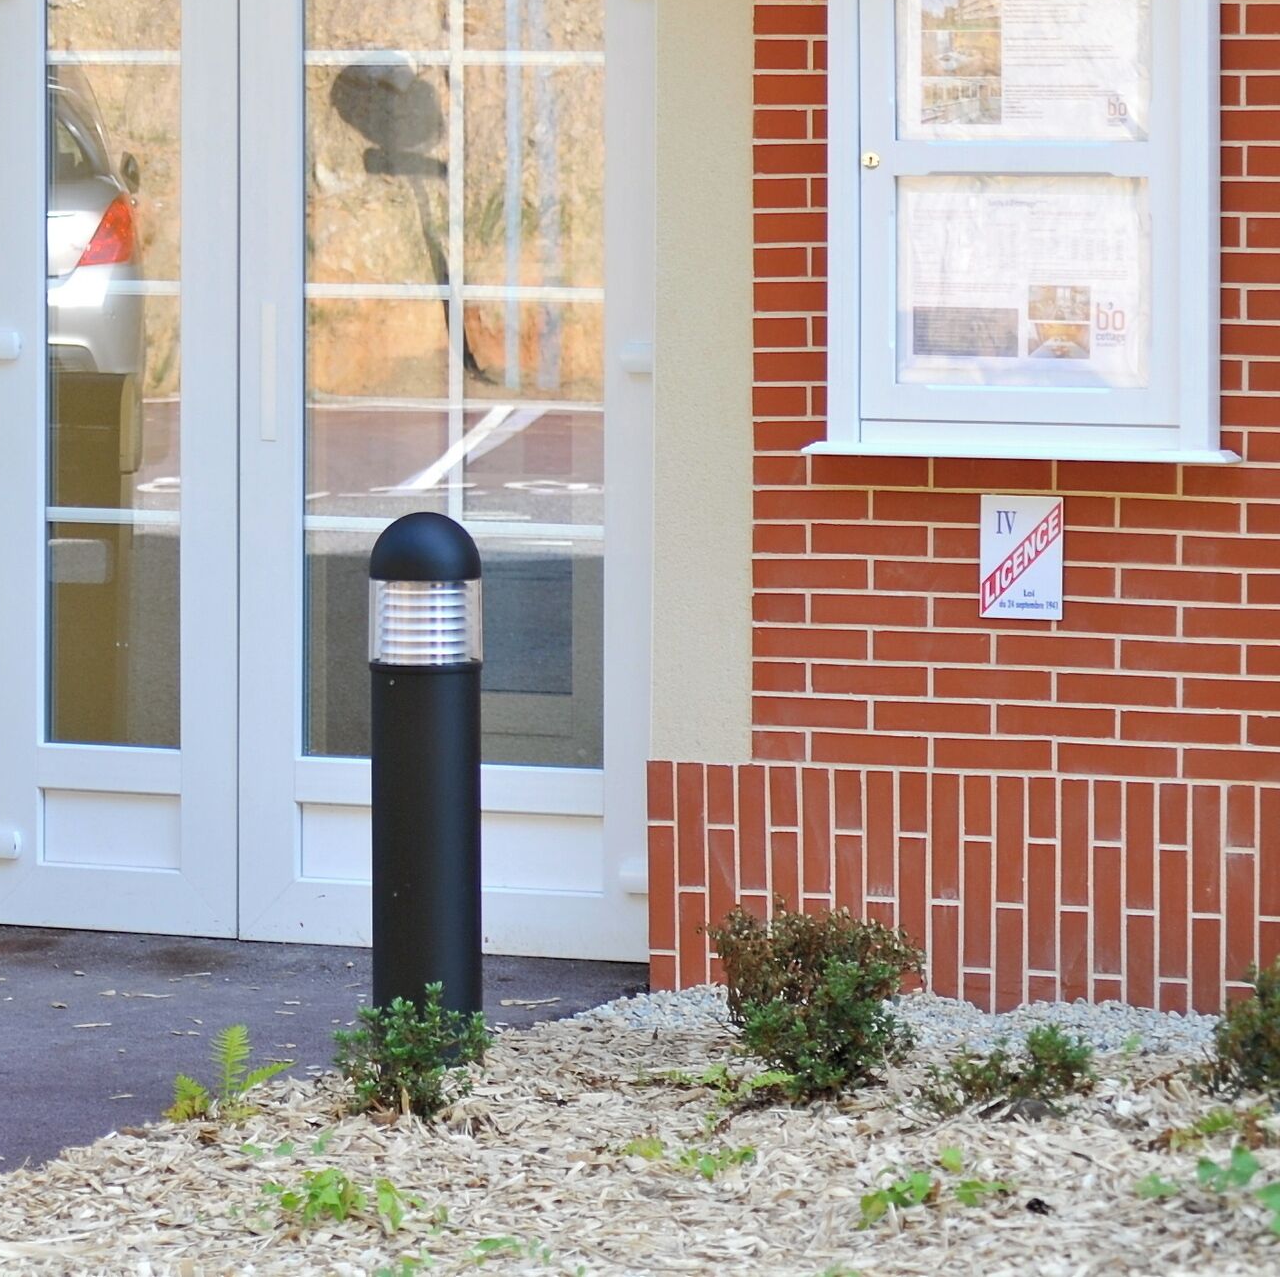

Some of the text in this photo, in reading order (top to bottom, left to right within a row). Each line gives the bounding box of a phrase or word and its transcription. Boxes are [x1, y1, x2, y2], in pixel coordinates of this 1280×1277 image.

[996, 510, 1017, 535] IV
[984, 508, 1060, 608] LICENCE
[1023, 589, 1035, 598] Loi
[1016, 600, 1044, 611] septembre
